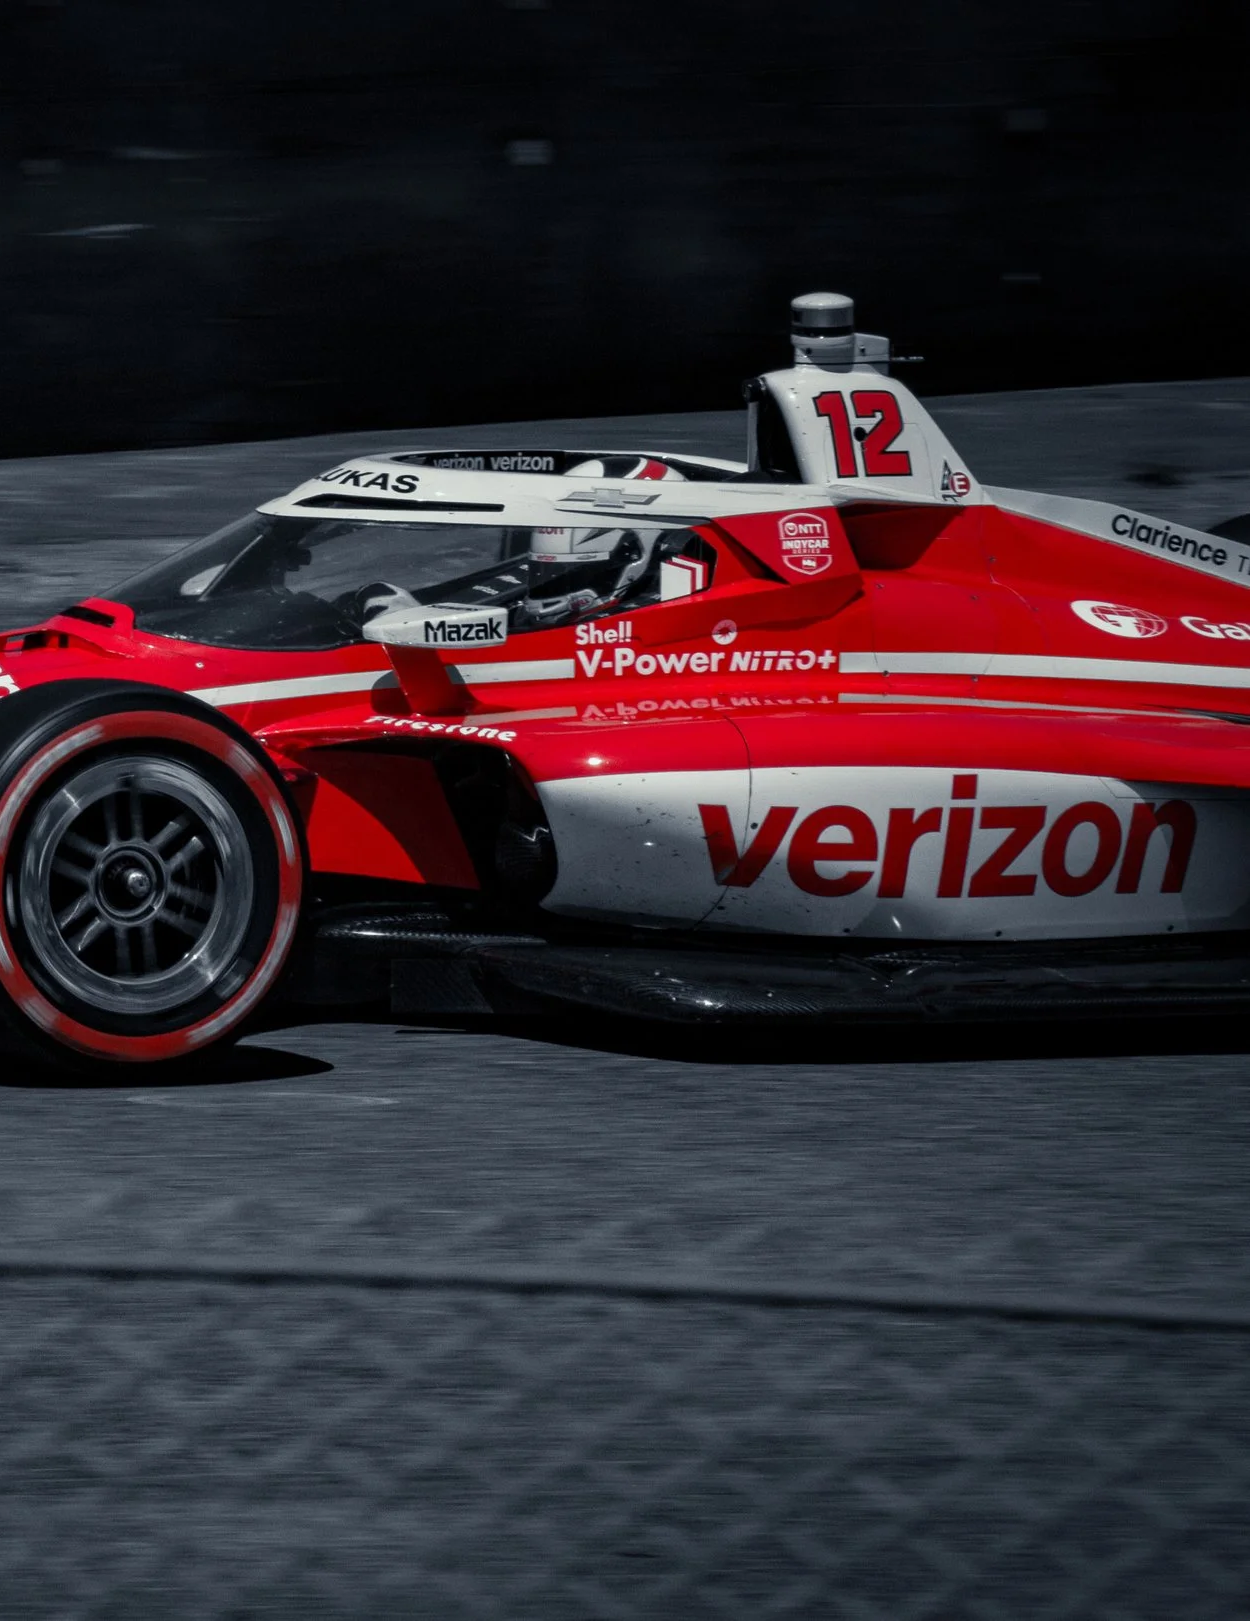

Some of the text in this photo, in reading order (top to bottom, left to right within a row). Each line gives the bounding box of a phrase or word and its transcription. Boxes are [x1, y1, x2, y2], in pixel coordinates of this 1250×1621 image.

[812, 389, 912, 479] 12
[490, 451, 555, 471] verizon
[798, 523, 822, 534] NTT
[1111, 514, 1228, 566] Clarience
[782, 539, 830, 549] INDYCAR
[424, 617, 504, 642] Mazak
[575, 621, 632, 645] Shell
[576, 648, 725, 678] V-Power
[363, 715, 517, 742] Firestone
[698, 774, 1197, 898] verizon
